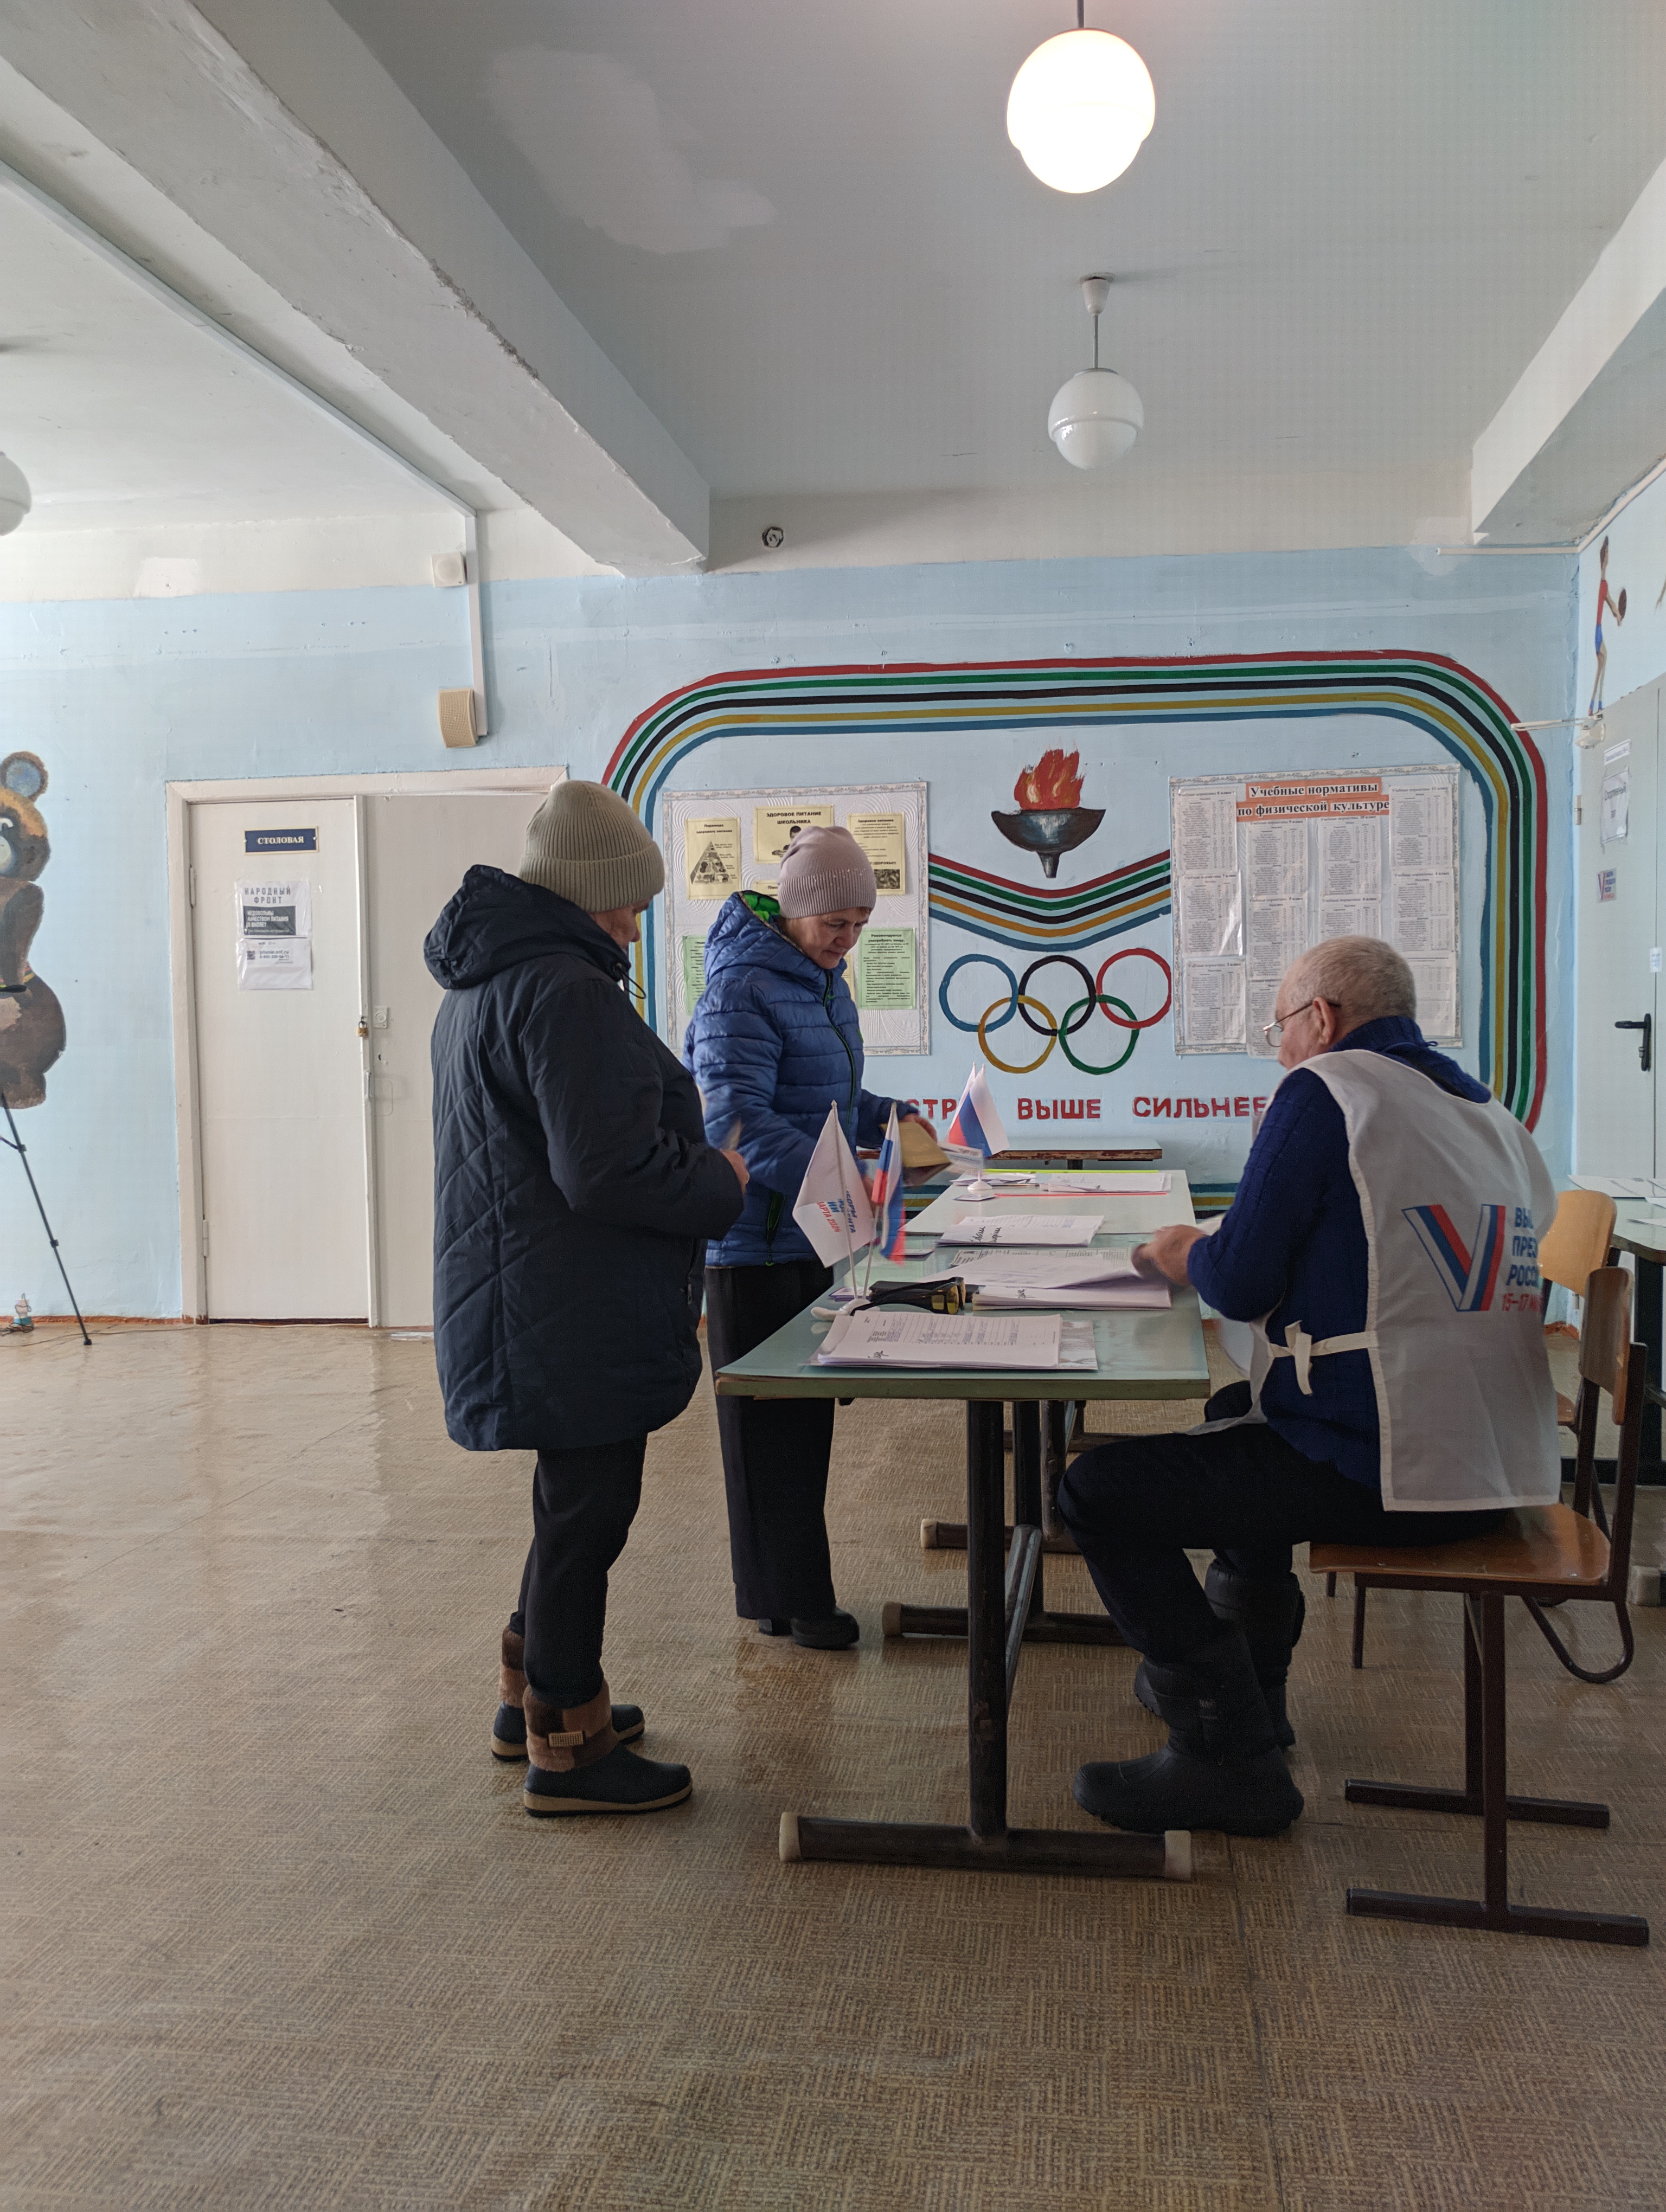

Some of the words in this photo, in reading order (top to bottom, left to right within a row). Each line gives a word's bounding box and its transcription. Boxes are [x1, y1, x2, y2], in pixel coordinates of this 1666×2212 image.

[1251, 786, 1304, 797] Учебные
[1308, 782, 1377, 796] нормативы
[1238, 808, 1252, 816] по
[1255, 801, 1327, 817] физической
[1333, 801, 1389, 813] культуре
[257, 835, 305, 845] СТОЛОВАЯ
[245, 886, 291, 896] НАРОДНЫЙ
[1017, 1098, 1101, 1120] ВЫШЕ
[1132, 1096, 1268, 1118] СИЛЬНЕЕ
